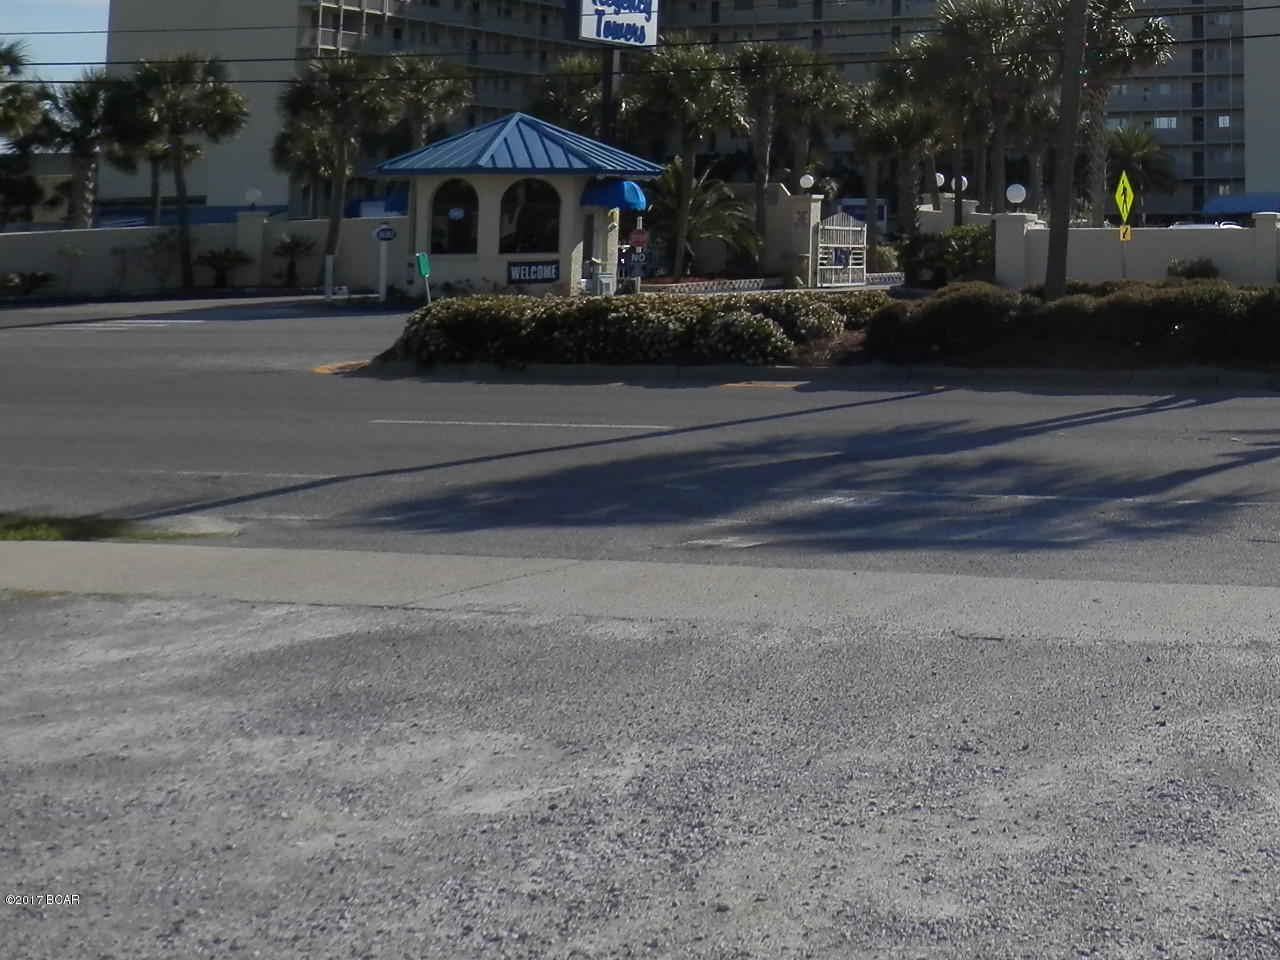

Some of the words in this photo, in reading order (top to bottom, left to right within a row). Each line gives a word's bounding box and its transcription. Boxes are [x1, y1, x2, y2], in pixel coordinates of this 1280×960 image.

[594, 8, 646, 44] Towers
[631, 253, 646, 263] NO
[511, 264, 557, 280] WELCOME
